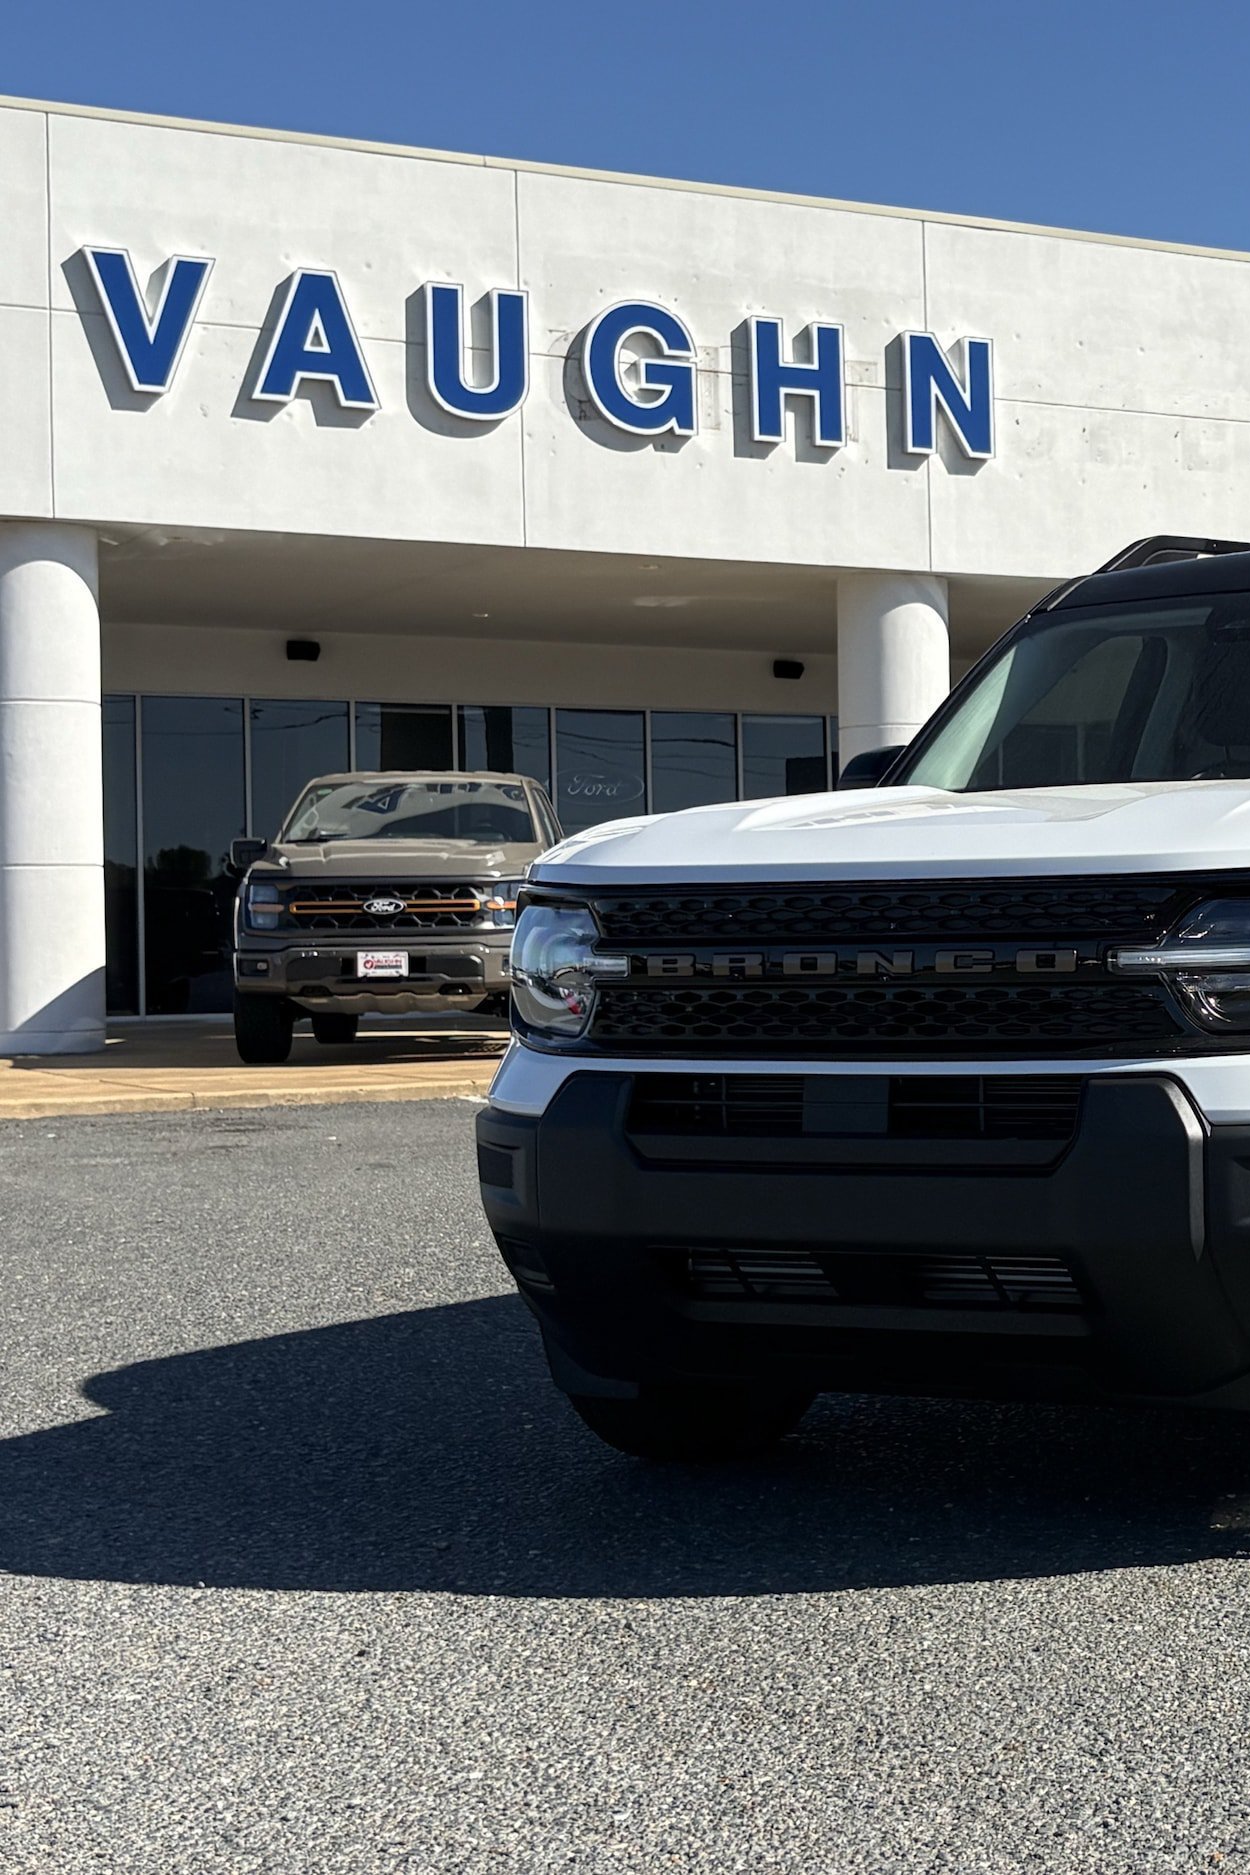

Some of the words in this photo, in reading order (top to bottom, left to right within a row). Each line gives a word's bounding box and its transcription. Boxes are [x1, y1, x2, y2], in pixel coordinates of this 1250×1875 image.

[83, 246, 996, 461] VAUGHN
[567, 774, 621, 796] Ford
[646, 950, 1077, 977] BRONCO
